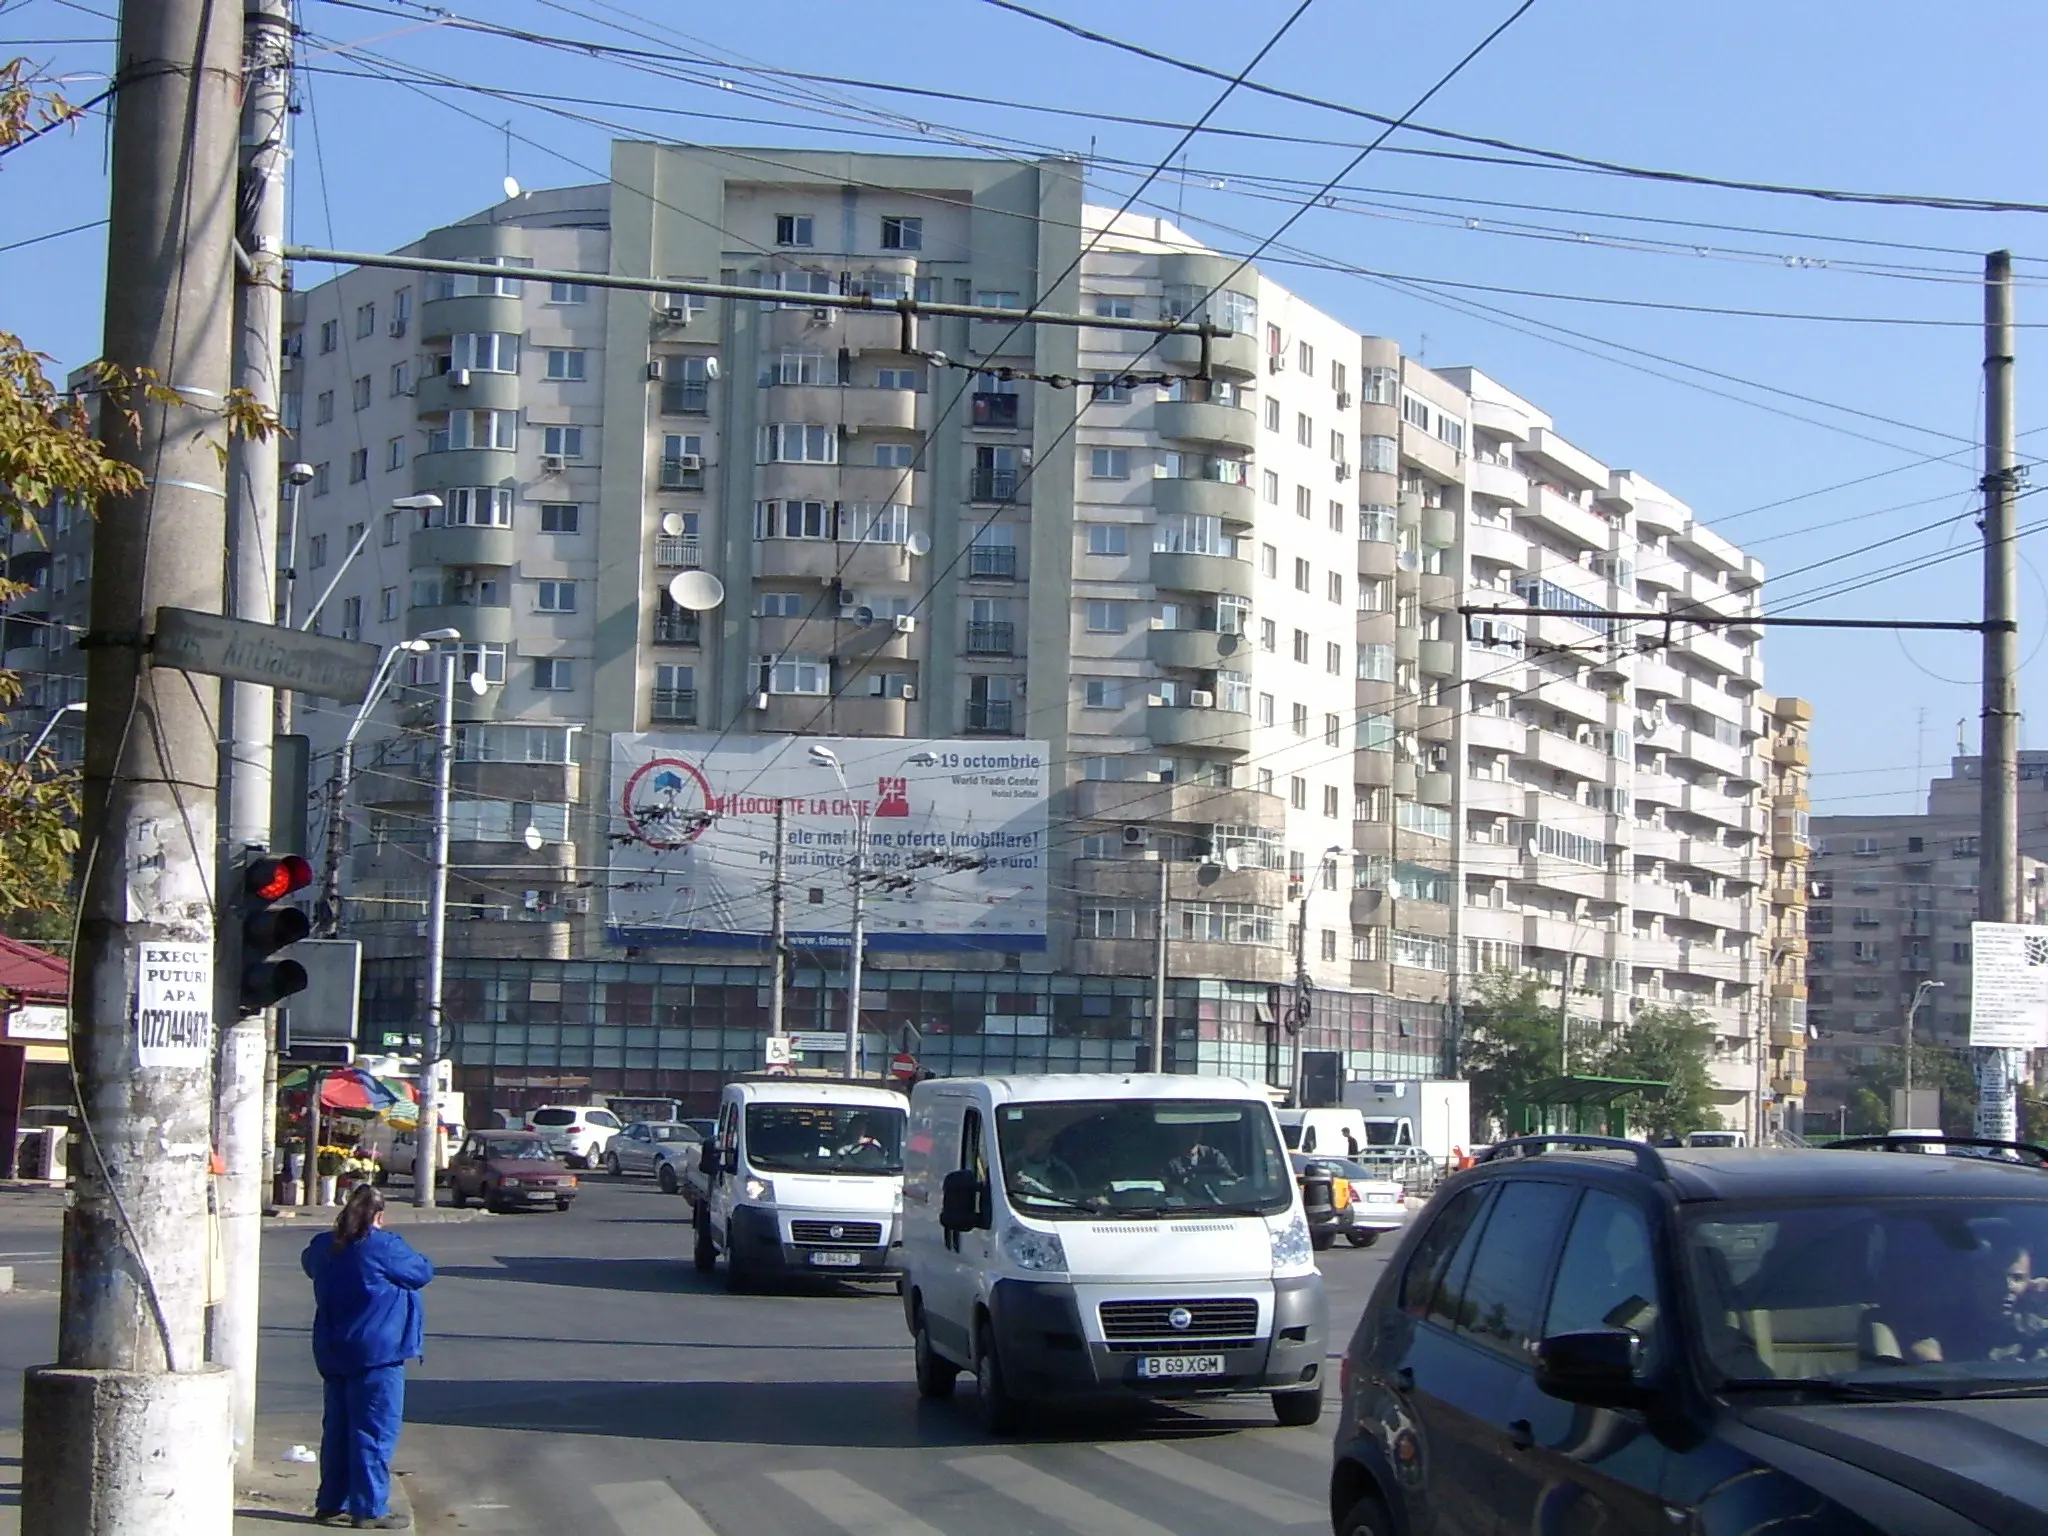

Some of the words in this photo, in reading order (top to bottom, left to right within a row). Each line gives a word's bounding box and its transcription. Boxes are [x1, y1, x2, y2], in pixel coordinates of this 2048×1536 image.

[963, 753, 1040, 768] octombrie
[951, 775, 978, 785] World
[980, 775, 1005, 786] Trade
[1007, 775, 1039, 786] Center
[810, 799, 828, 815] LA
[788, 829, 812, 845] ele
[817, 829, 848, 845] mai
[897, 830, 946, 847] oferte
[951, 831, 1039, 848] imobiliare!
[1001, 855, 1038, 869] euro!
[162, 989, 196, 1002] APA
[1149, 1359, 1161, 1374] B
[1165, 1359, 1184, 1373] 69
[1187, 1358, 1218, 1372] XGM
